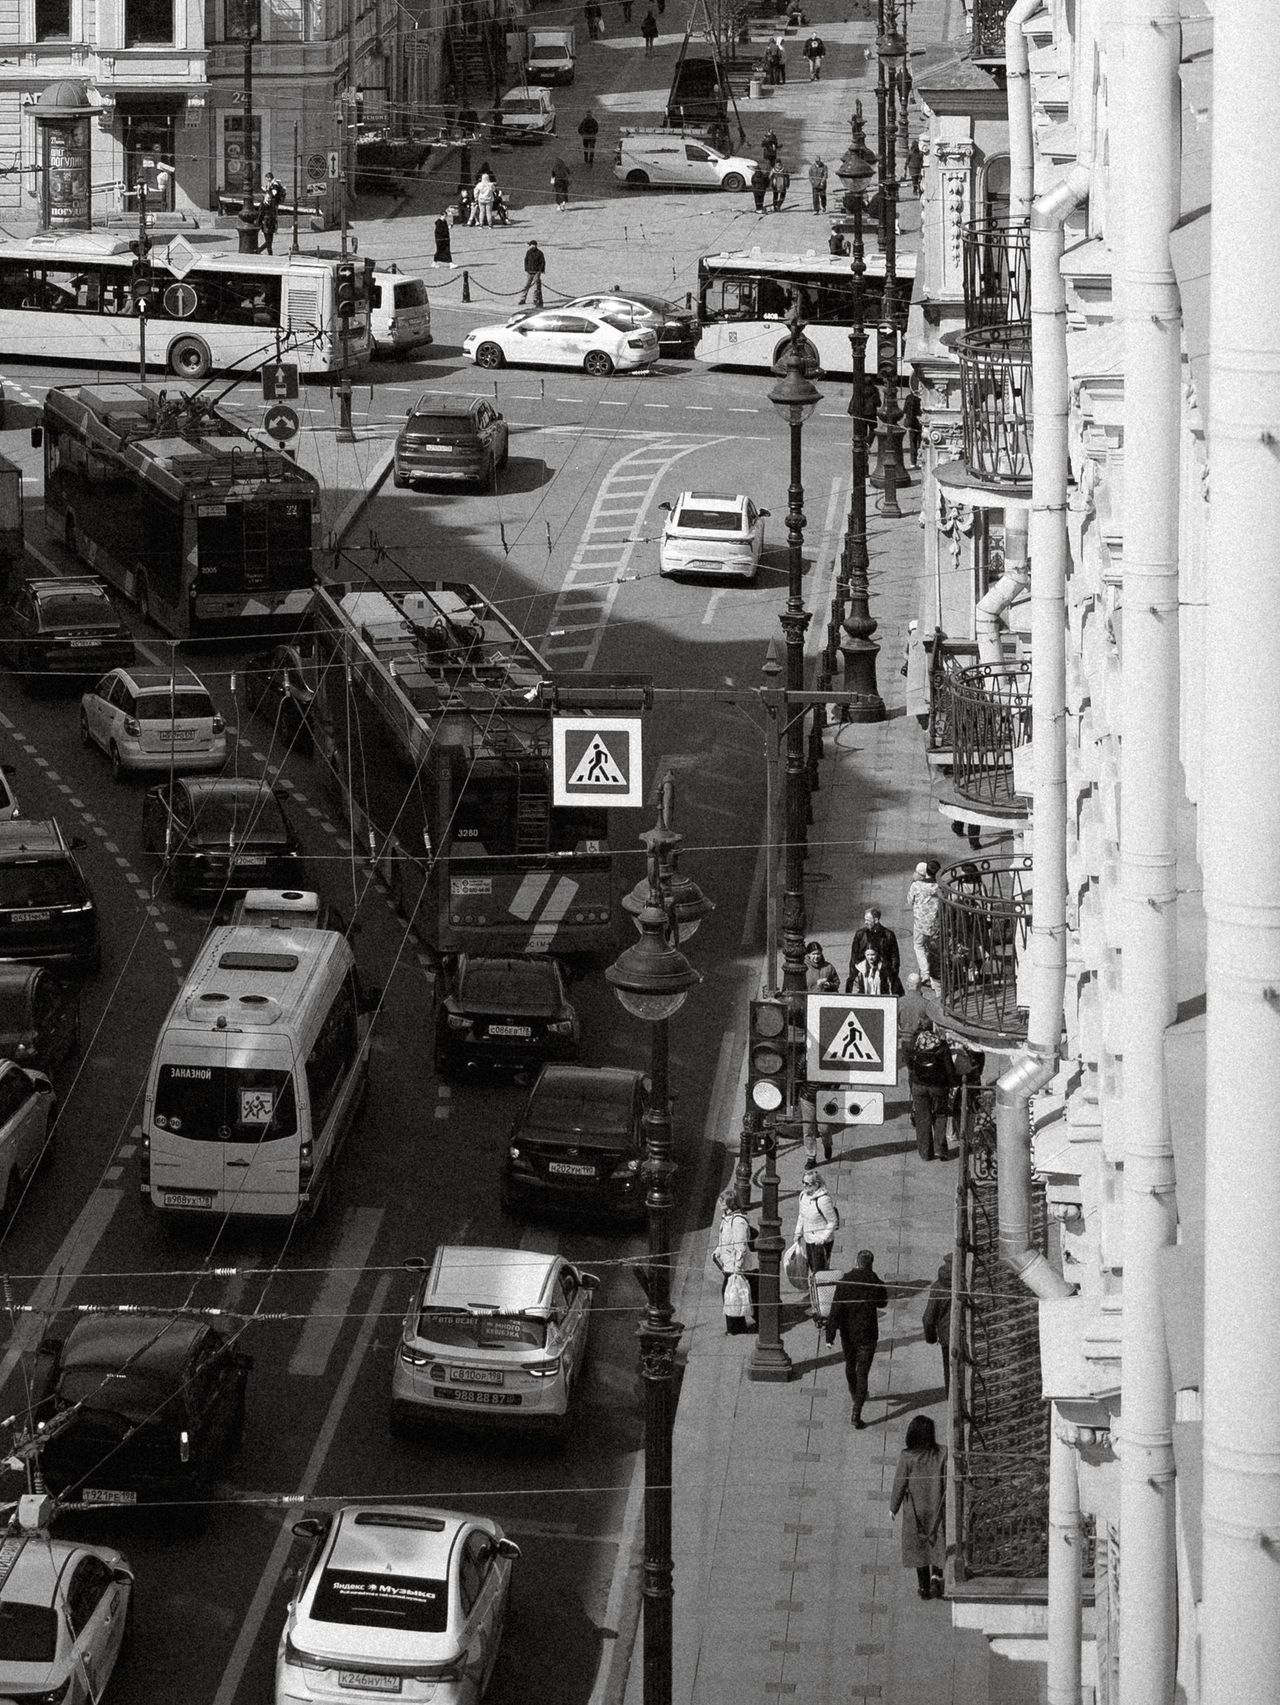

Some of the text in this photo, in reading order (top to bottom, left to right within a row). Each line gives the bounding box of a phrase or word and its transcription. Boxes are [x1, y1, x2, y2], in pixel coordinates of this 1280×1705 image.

[457, 828, 479, 837] 3280
[170, 1067, 212, 1080] ЗАКАЗНОЙ
[494, 1323, 521, 1332] МНОГО
[454, 1390, 475, 1401] 988
[476, 1392, 491, 1402] 88
[491, 1393, 506, 1404] 87
[333, 1582, 436, 1599] Яндекс Музыка
[341, 1673, 381, 1686] К246НУ
